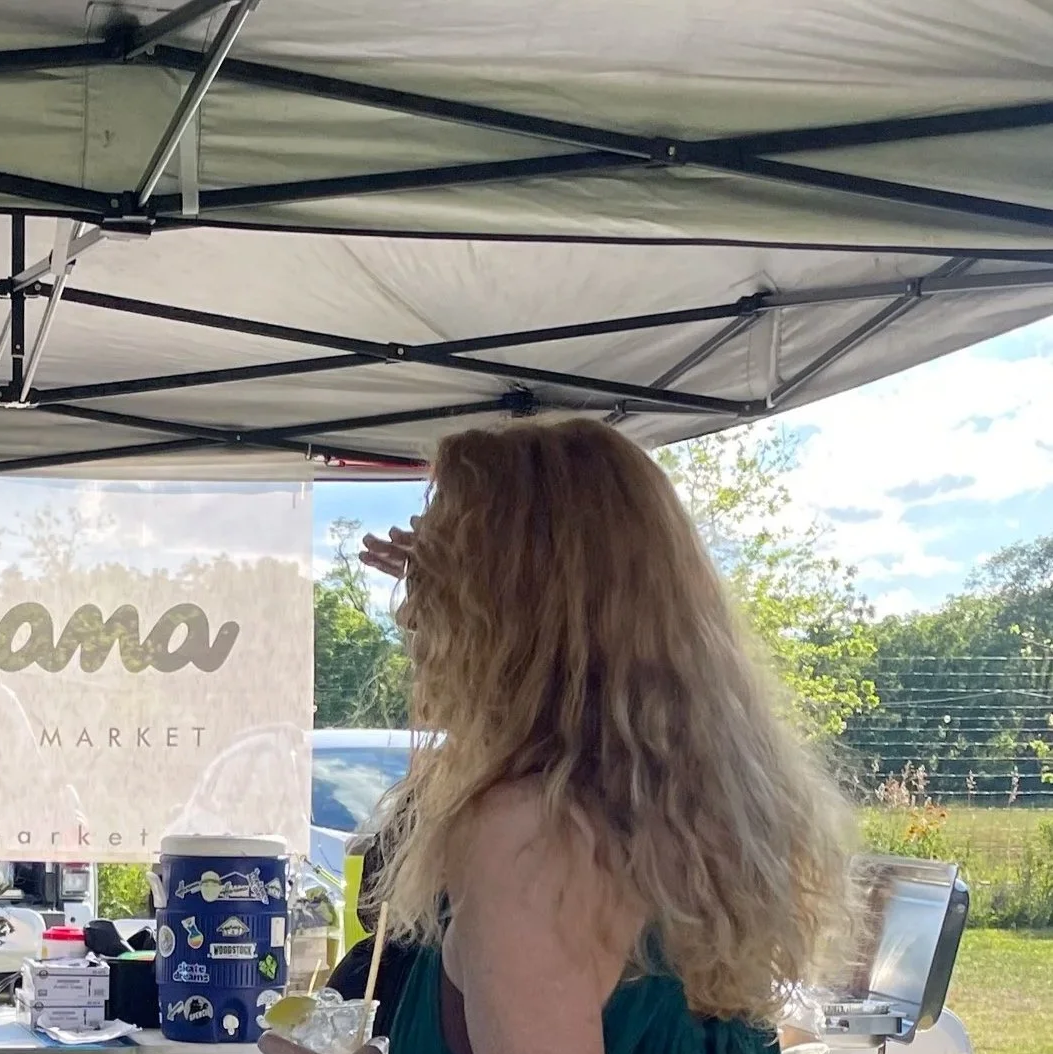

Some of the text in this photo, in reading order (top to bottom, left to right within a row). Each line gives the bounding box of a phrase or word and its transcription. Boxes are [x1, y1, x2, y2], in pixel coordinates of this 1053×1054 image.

[40, 726, 206, 748] MARKET
[213, 945, 252, 957] WOODSTOCK
[173, 971, 210, 982] dreams
